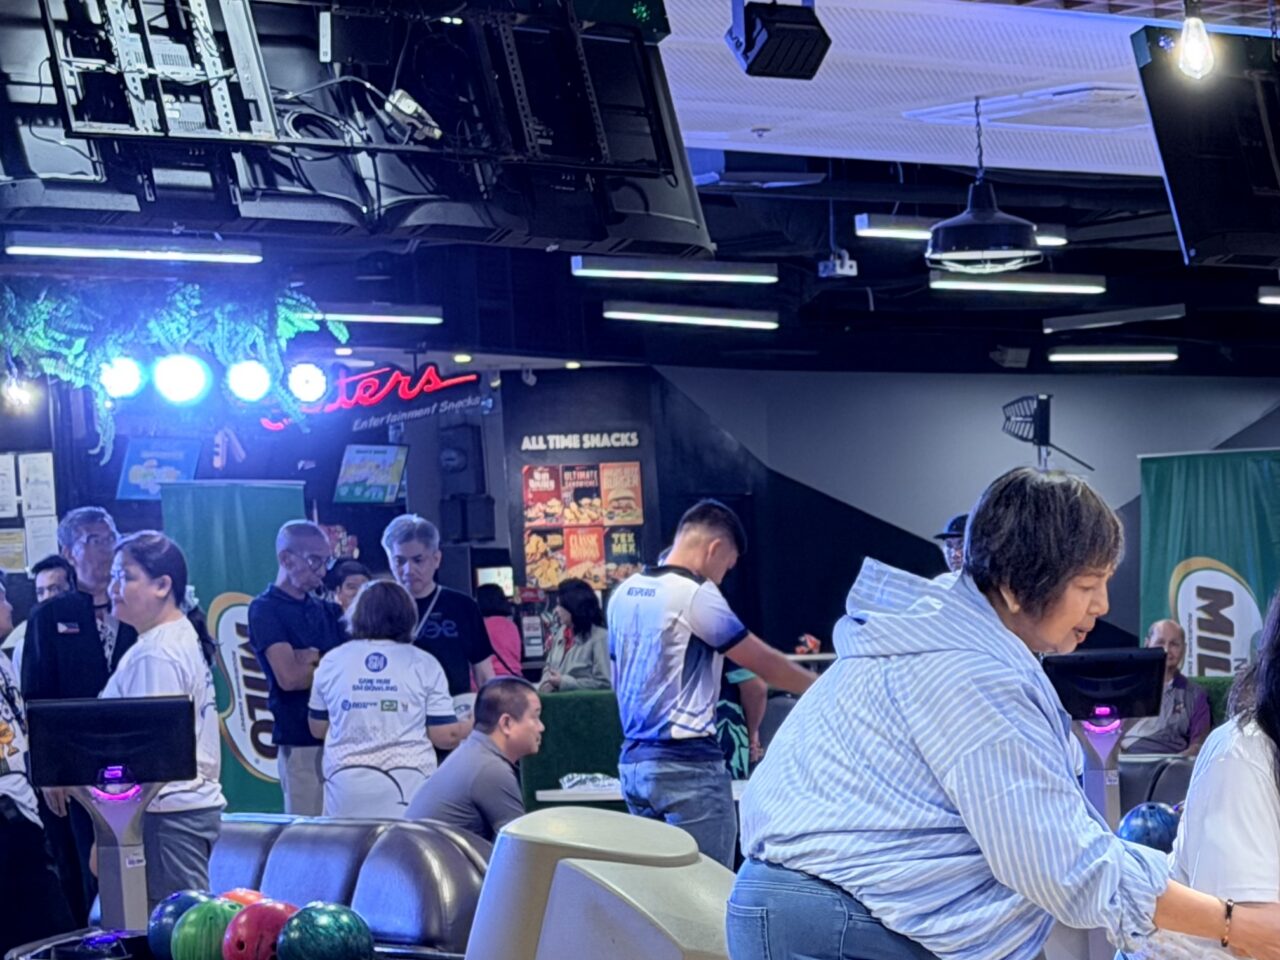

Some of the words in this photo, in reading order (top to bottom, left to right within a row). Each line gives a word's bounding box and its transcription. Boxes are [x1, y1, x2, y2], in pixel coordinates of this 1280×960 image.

[352, 406, 437, 432] Entertainment
[439, 396, 481, 413] Snacks
[521, 435, 547, 450] ALL
[547, 434, 580, 450] TIME
[582, 432, 639, 449] SNACKS
[1196, 586, 1234, 676] MIL
